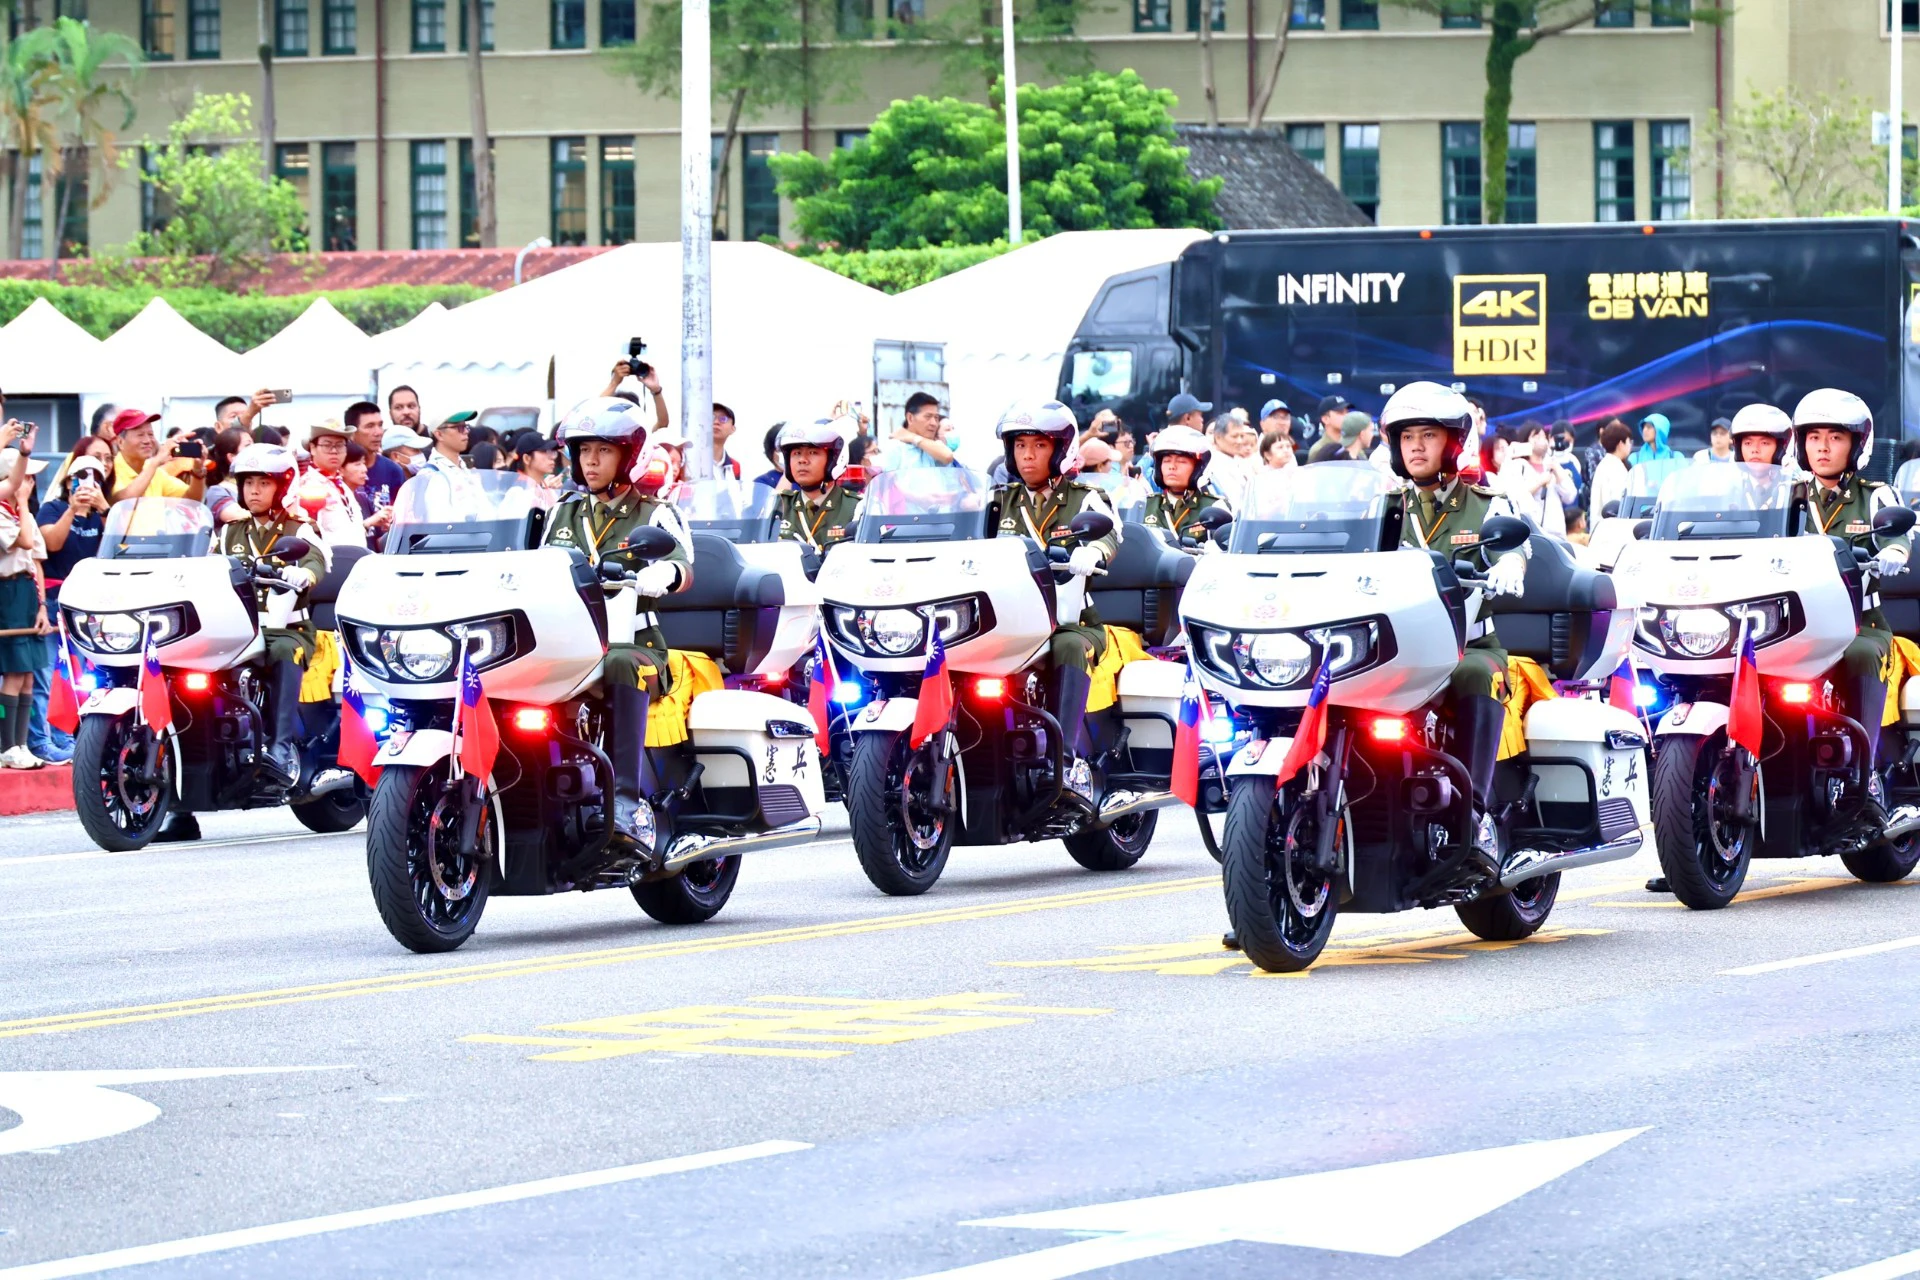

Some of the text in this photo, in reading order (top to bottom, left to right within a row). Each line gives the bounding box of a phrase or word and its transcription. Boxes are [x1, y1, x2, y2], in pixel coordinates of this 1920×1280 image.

[1278, 272, 1405, 305] INFINITY
[1461, 290, 1537, 317] 4K
[1588, 296, 1708, 319] OB VAN
[1463, 338, 1536, 362] HDR
